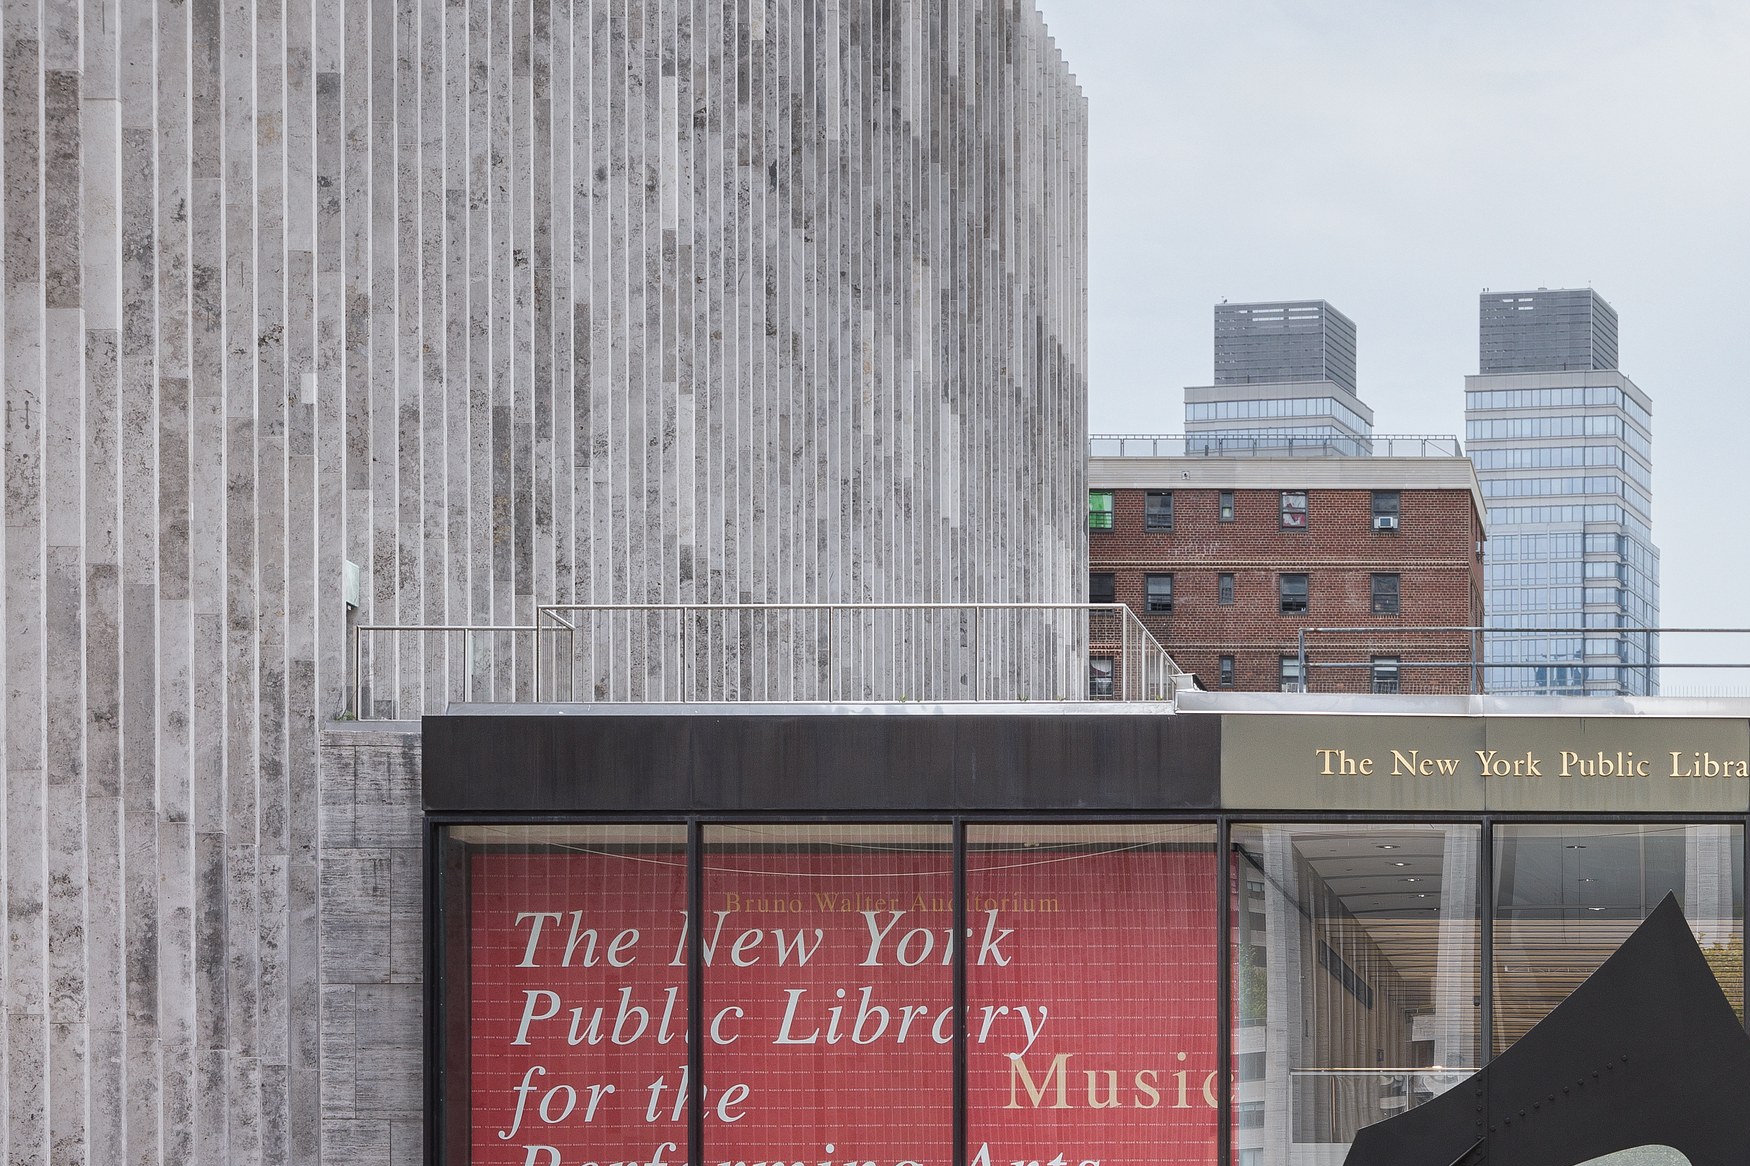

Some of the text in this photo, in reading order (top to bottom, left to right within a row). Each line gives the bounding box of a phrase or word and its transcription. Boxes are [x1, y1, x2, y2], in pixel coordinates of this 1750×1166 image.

[1315, 749, 1373, 777] The
[1390, 749, 1461, 777] New
[1475, 749, 1543, 778] York
[1558, 750, 1650, 778] Public
[725, 893, 804, 914] Bruno
[814, 892, 901, 914] Walter
[513, 909, 1015, 968] The New York
[509, 986, 1048, 1059] Publc Library
[497, 1064, 617, 1141] for
[644, 1064, 751, 1124] the
[1001, 1051, 1236, 1110] Music
